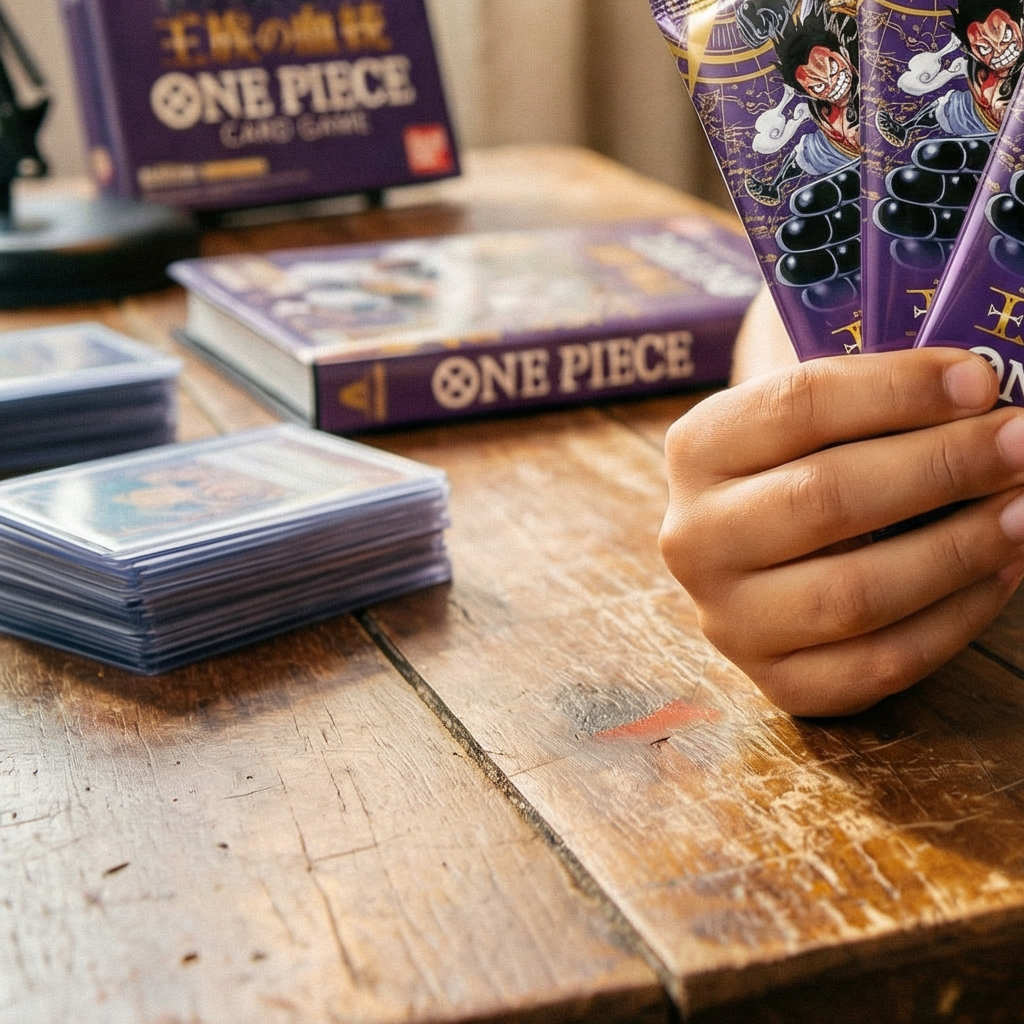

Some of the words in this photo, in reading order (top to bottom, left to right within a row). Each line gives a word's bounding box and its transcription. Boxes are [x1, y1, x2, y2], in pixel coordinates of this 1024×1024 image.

[151, 67, 275, 130] ONE
[277, 54, 417, 116] PIECE
[431, 348, 551, 410] ONE
[558, 330, 695, 394] PIECE
